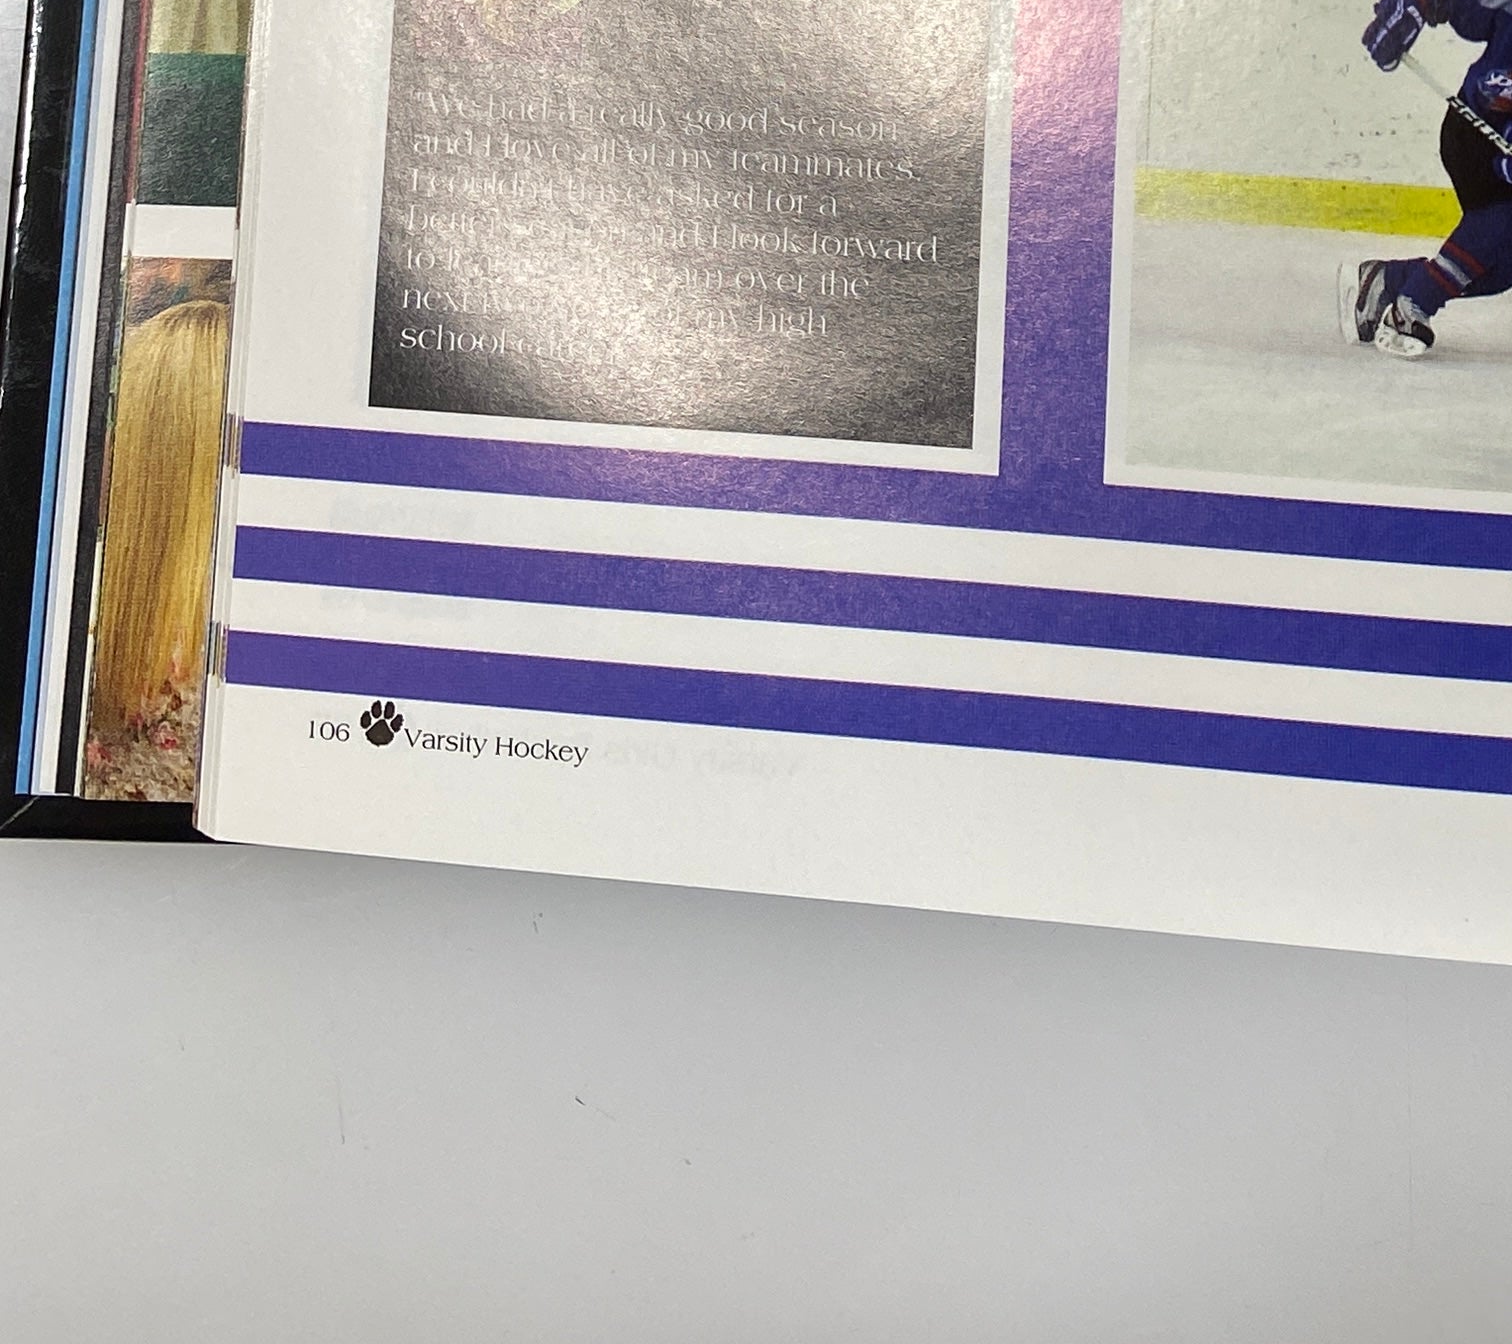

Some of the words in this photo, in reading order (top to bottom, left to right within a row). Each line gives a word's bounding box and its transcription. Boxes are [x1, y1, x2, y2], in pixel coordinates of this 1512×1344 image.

[684, 108, 768, 137] good
[399, 324, 506, 355] school
[308, 720, 351, 743] 106
[403, 727, 488, 759] Varsity
[494, 736, 590, 768] Hockey
